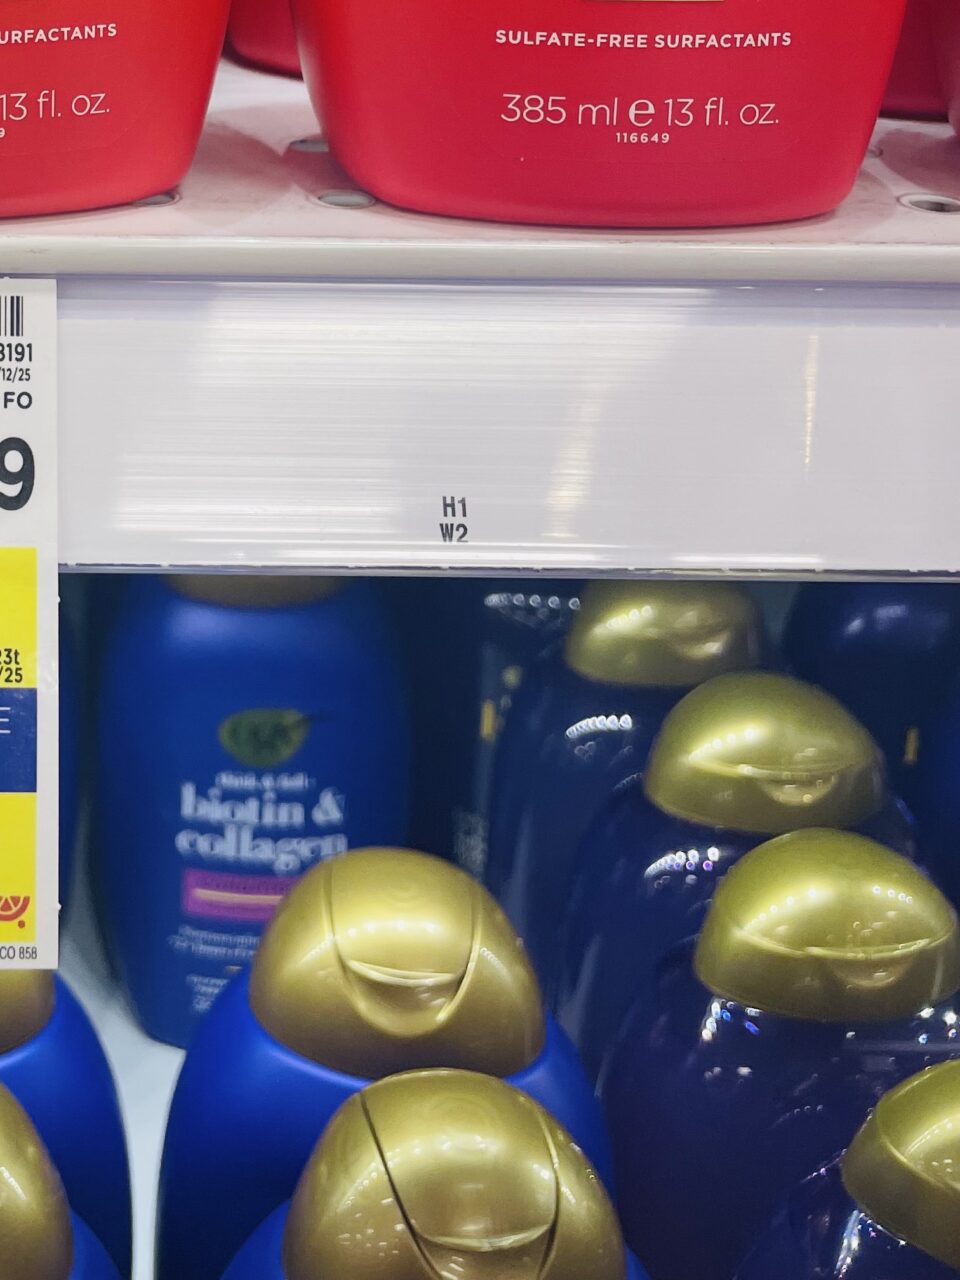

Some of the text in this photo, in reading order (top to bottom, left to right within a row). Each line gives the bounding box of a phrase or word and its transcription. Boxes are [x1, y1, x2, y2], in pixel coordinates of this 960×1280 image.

[495, 29, 792, 49] SULFATE-FREE SURFACTANTS
[37, 90, 63, 119] fl.
[71, 91, 111, 117] oz.
[500, 93, 779, 126] 385 ml 13 fl. oz.
[615, 131, 671, 144] 116649
[3, 392, 33, 410] FO
[442, 496, 467, 517] H1
[439, 523, 469, 543] W2
[0, 946, 16, 960] CO
[18, 946, 38, 960] 858
